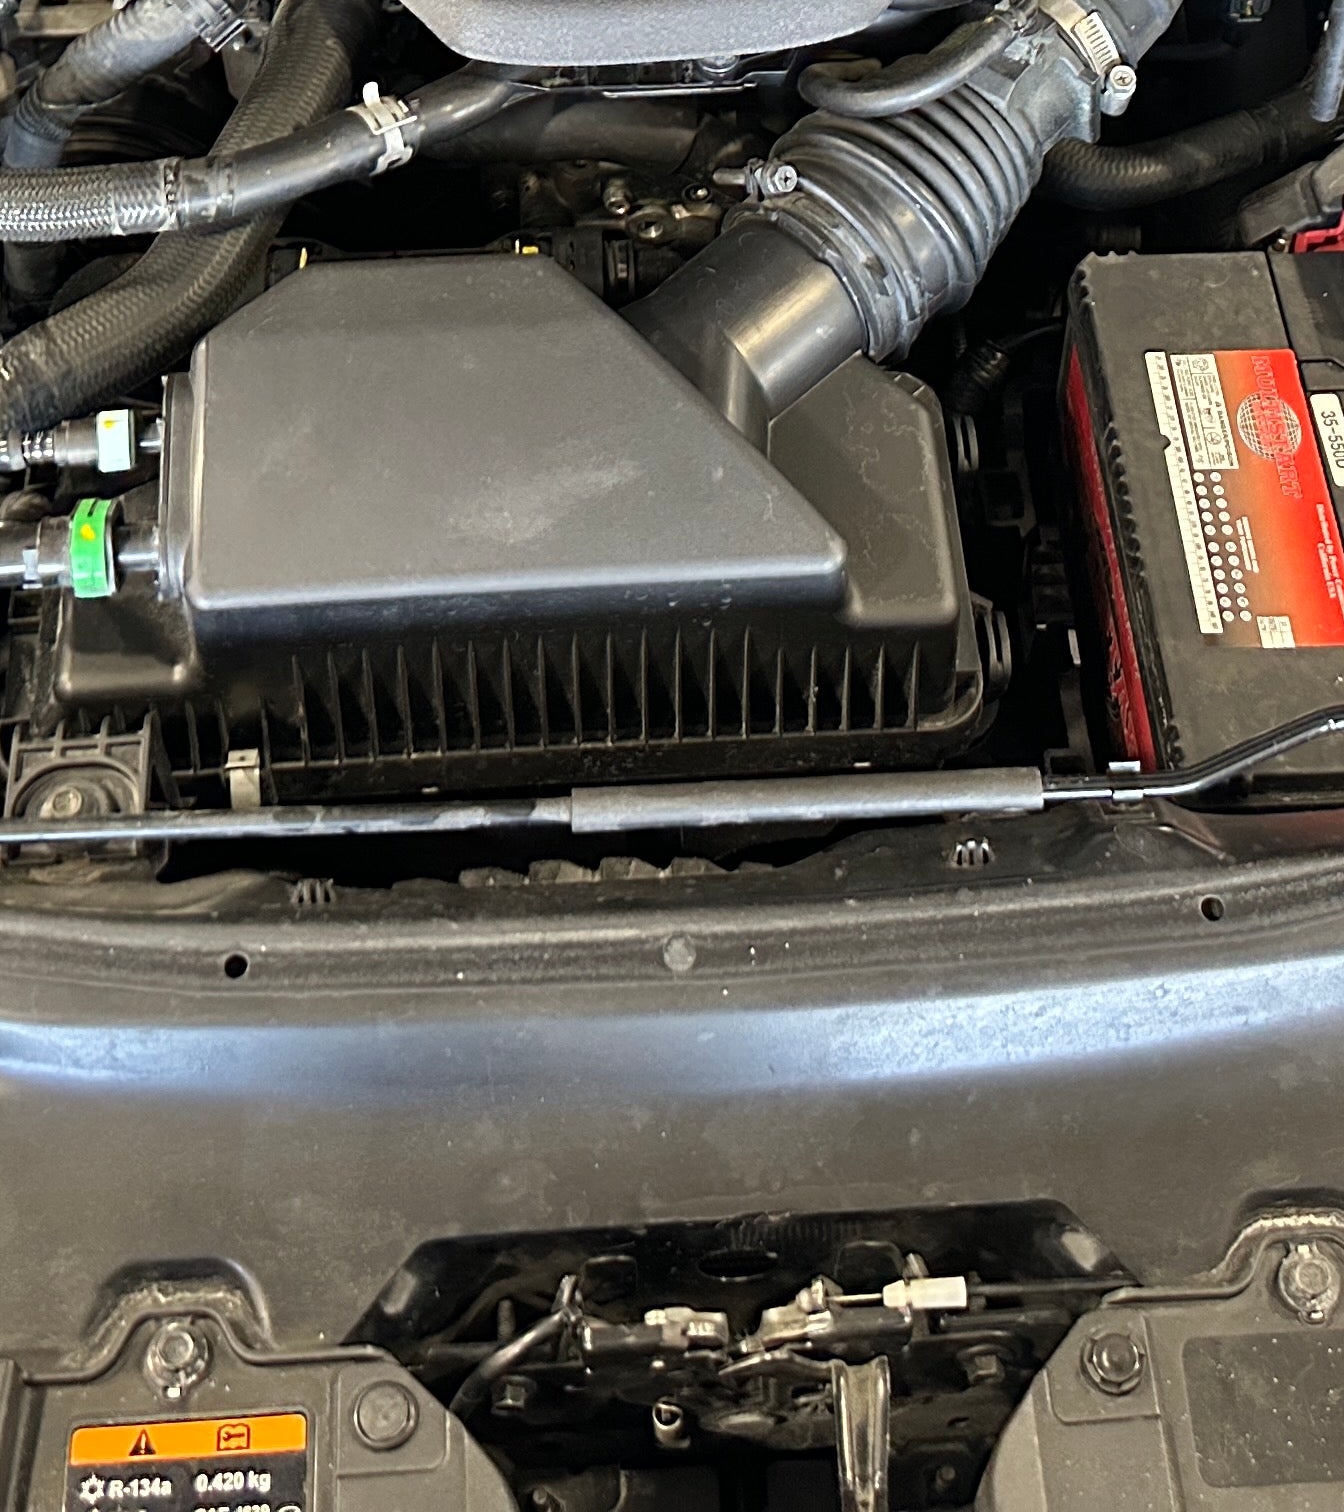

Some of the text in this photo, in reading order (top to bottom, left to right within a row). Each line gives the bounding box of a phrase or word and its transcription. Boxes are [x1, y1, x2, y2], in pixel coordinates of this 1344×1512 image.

[1250, 355, 1304, 498] MULTISTART
[1325, 580, 1337, 599] USA
[108, 1469, 272, 1500] R-134a 0.420 kg
